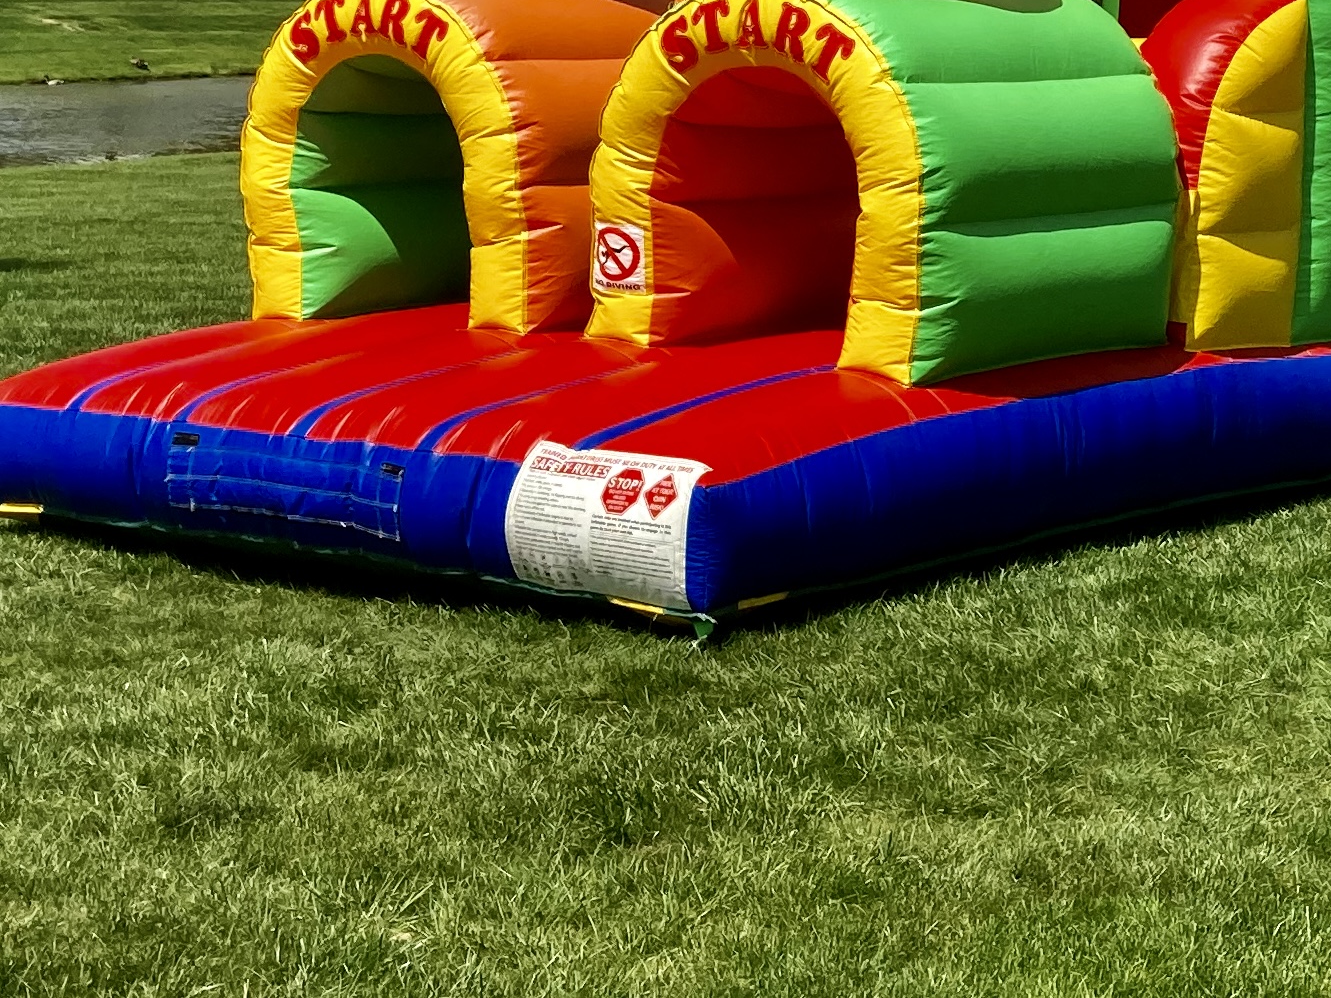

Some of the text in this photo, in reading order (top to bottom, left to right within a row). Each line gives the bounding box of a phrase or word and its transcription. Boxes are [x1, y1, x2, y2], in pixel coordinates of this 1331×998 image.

[606, 281, 641, 291] DIVING
[531, 456, 576, 474] SAFETY
[571, 462, 611, 478] RULES
[608, 477, 644, 492] STOP!
